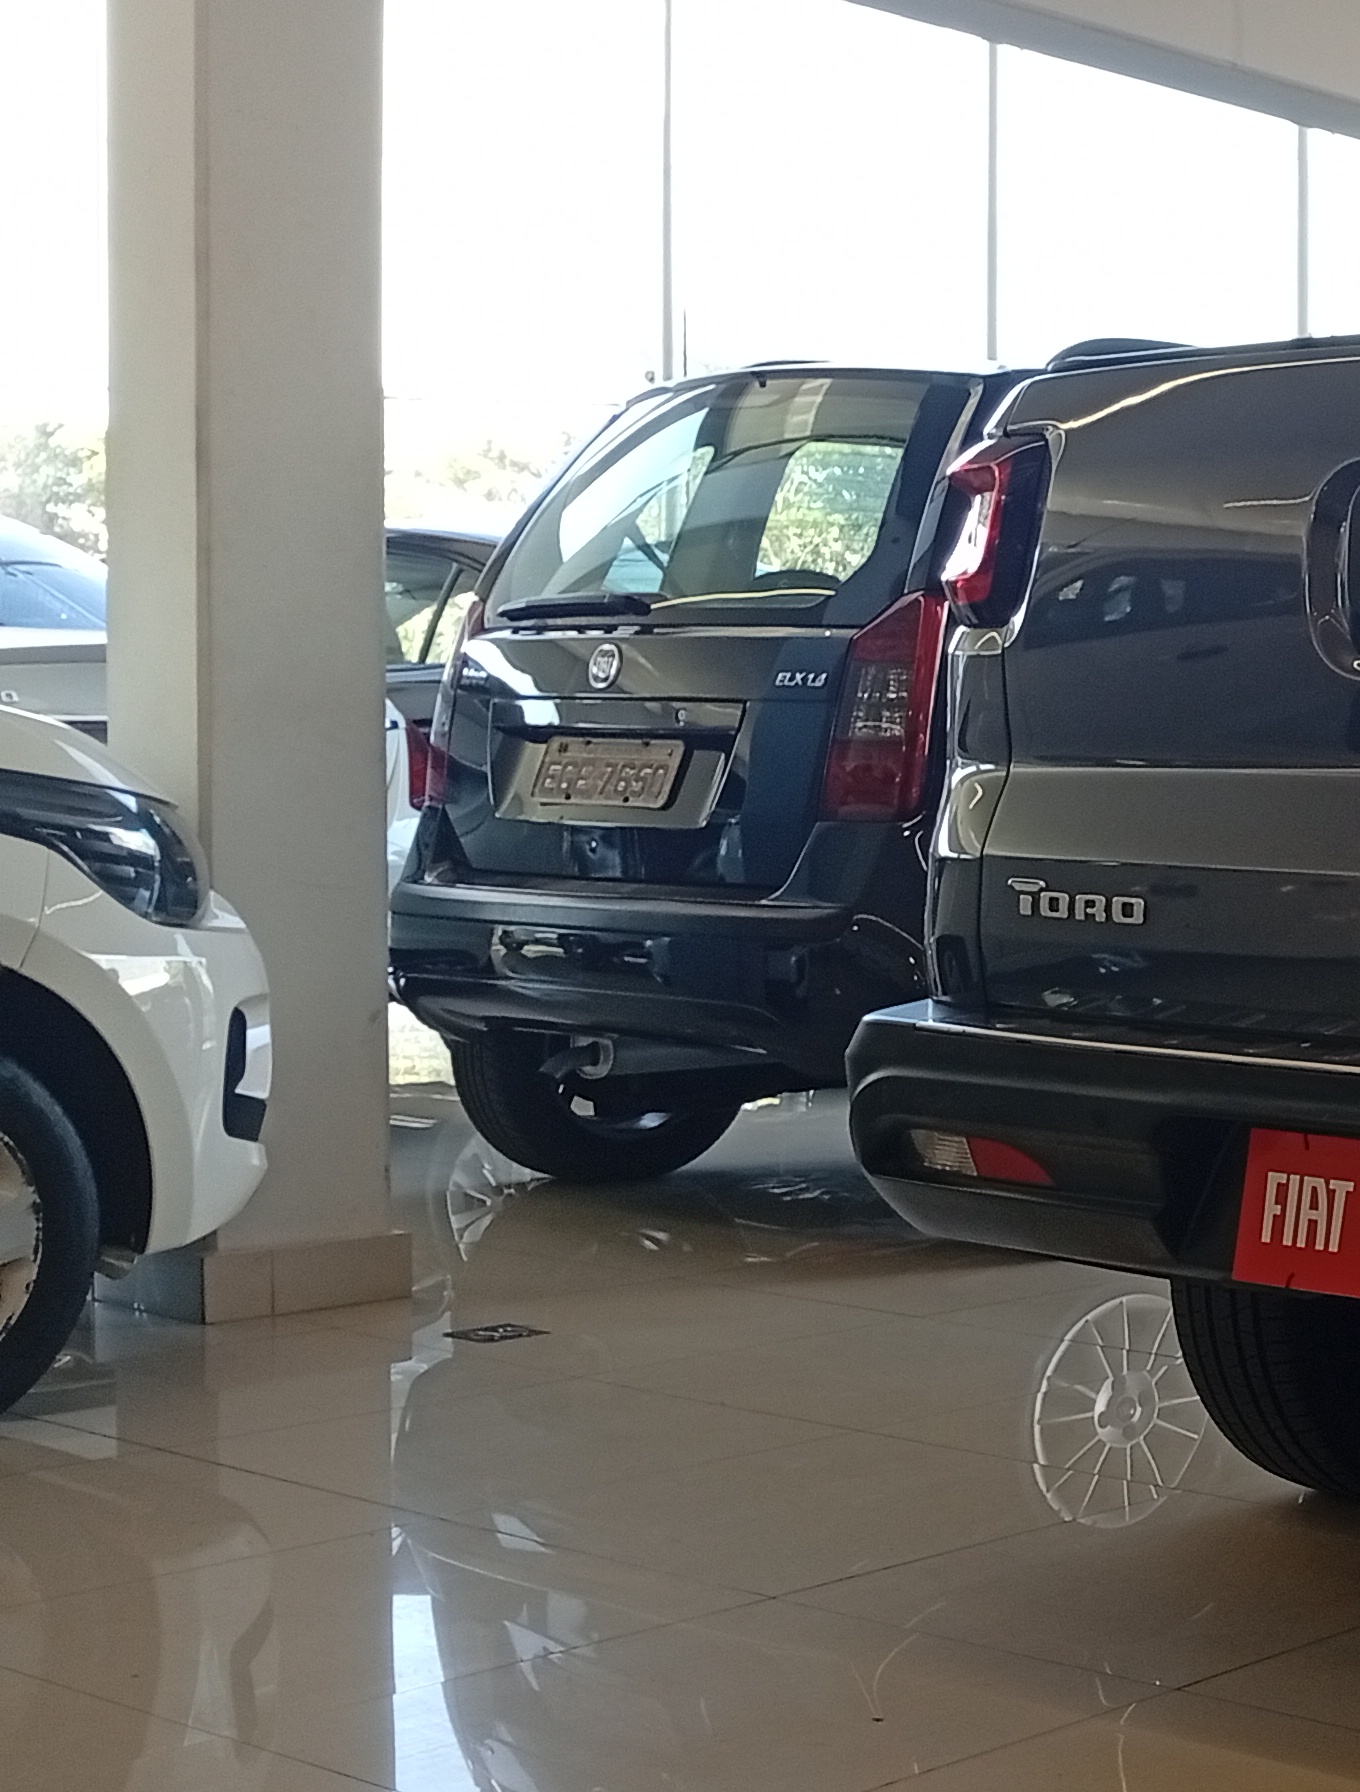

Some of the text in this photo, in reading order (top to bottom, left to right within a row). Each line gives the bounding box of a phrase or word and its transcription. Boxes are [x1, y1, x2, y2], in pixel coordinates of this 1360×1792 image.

[775, 672, 806, 686] ELX
[1007, 877, 1145, 925] TORO
[1261, 1171, 1354, 1253] FIAT
